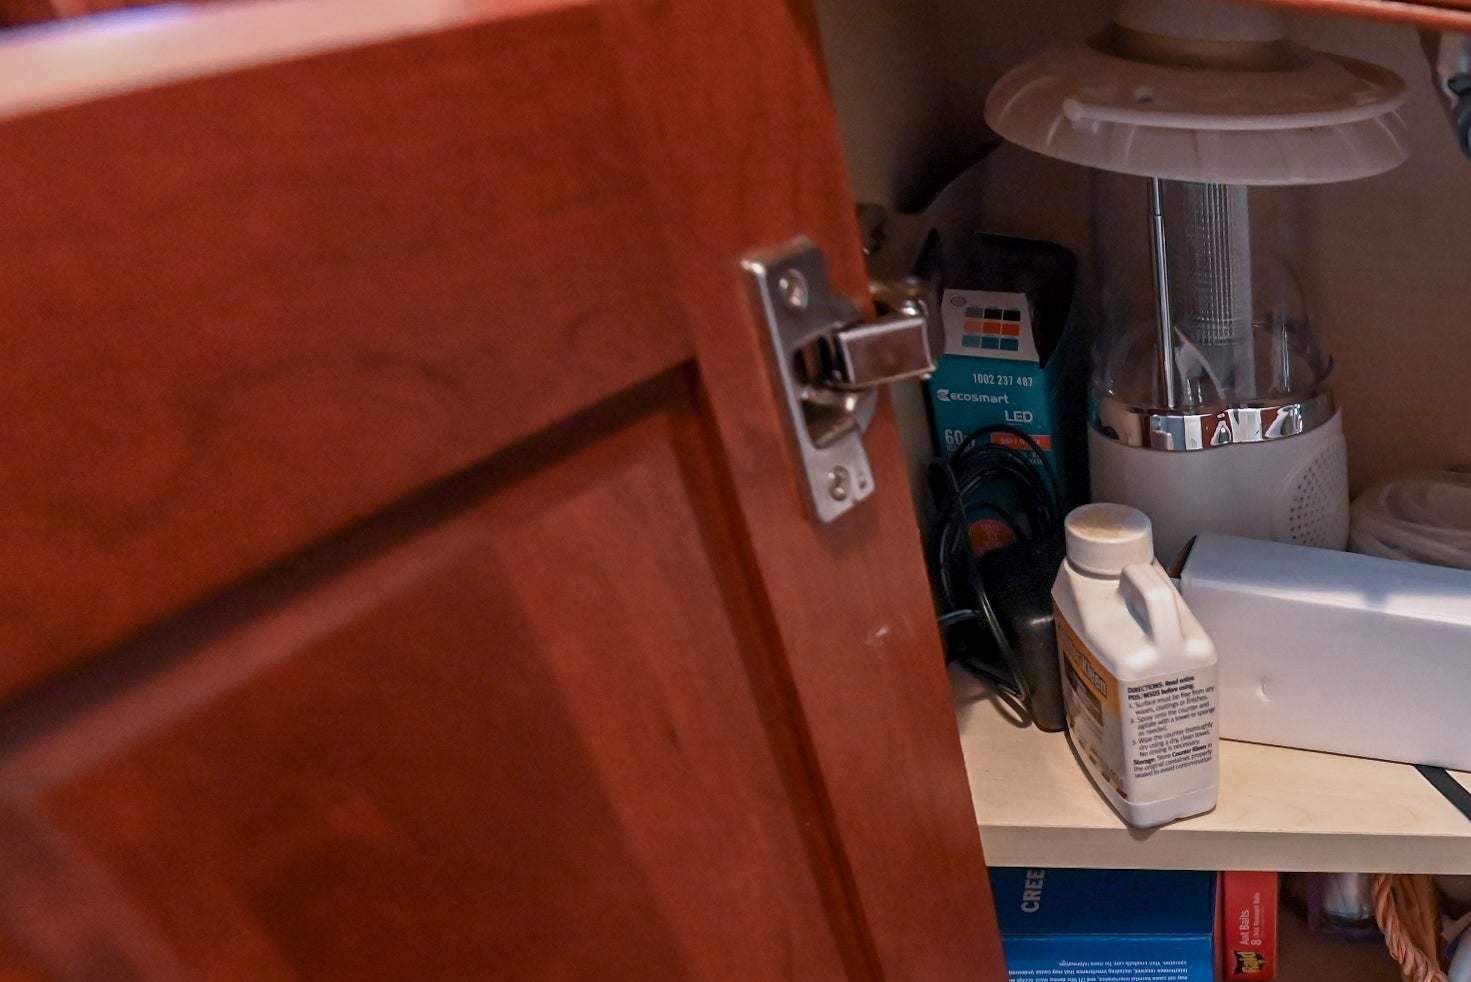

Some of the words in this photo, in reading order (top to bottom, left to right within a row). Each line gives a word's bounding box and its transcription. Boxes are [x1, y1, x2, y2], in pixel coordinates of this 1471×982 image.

[973, 374, 995, 384] 1002
[998, 375, 1013, 386] 237
[1005, 410, 1033, 422] LED
[1172, 748, 1191, 757] Counter
[1021, 869, 1045, 913] CREE
[1240, 909, 1249, 931] Baits
[1240, 932, 1249, 946] Ant
[1251, 938, 1261, 946] 8
[1236, 950, 1260, 974] Raid
